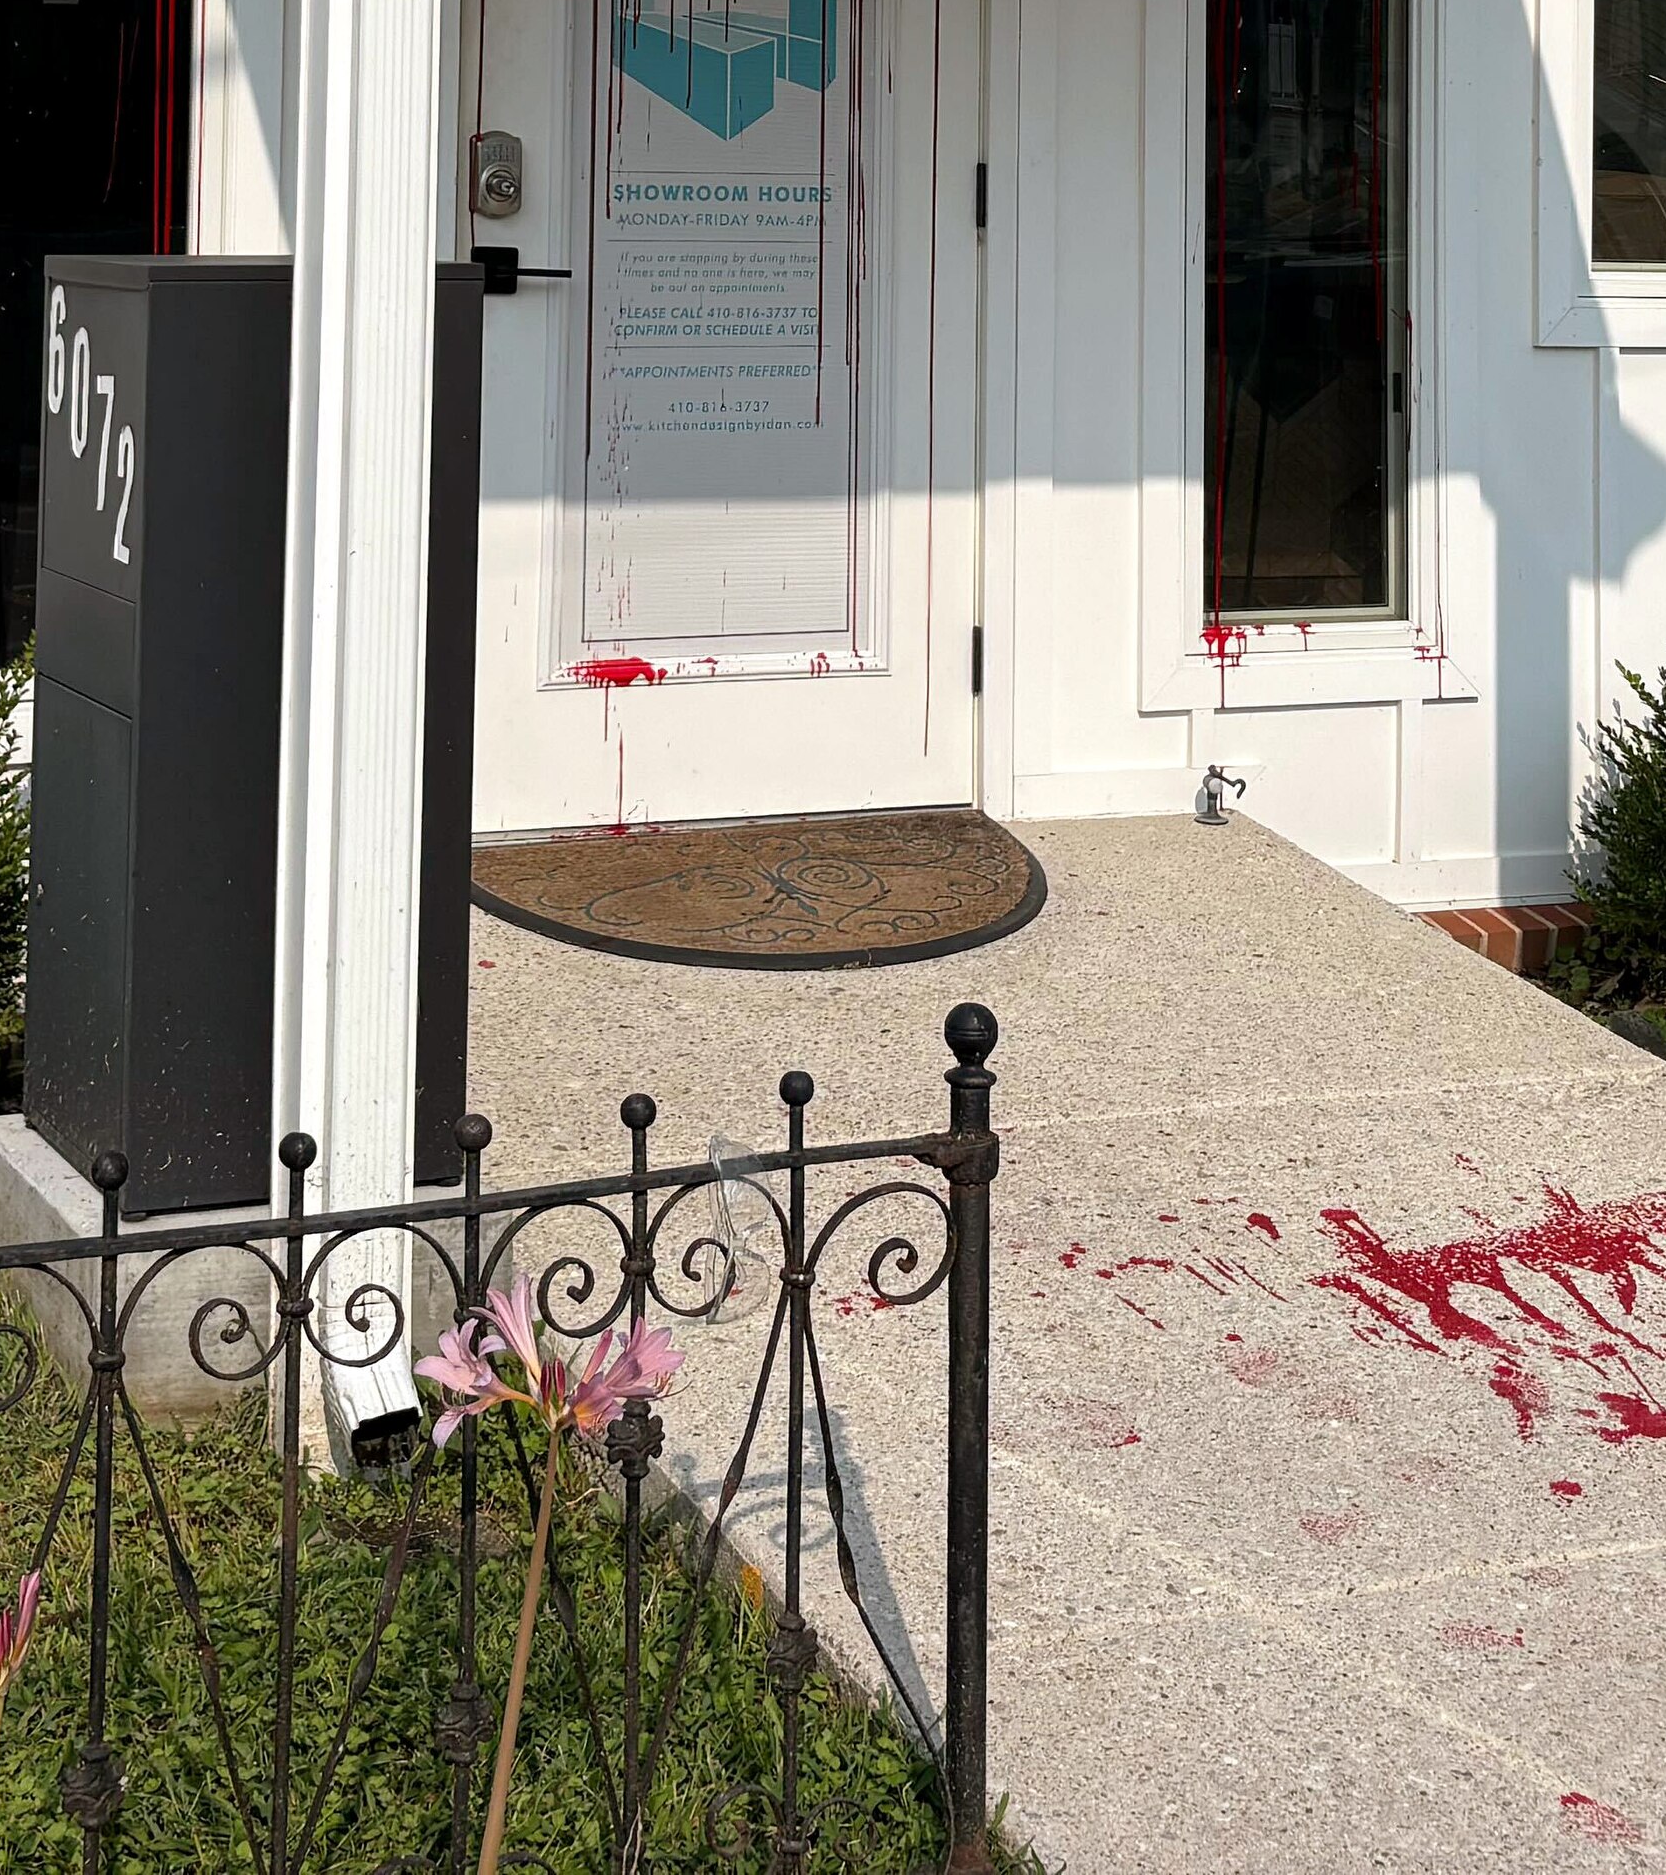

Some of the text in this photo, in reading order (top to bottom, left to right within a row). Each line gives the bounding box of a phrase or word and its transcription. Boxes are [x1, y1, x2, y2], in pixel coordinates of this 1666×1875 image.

[614, 184, 833, 203] SHOWROOM HOURS
[616, 212, 750, 228] MONDAY-FRIDAY
[633, 254, 653, 264] you
[657, 254, 676, 263] are
[679, 252, 728, 265] stopping
[732, 252, 746, 264] by
[749, 252, 786, 265] during
[658, 267, 680, 278] and
[683, 269, 698, 278] no
[702, 269, 723, 278] one
[773, 270, 788, 278] we
[792, 270, 816, 280] may
[650, 282, 665, 293] be
[668, 283, 687, 293] out
[619, 306, 818, 319] PLEASE CALL 410-816-3737 TO
[614, 324, 678, 337] CONFIRM
[682, 324, 701, 336] OR
[705, 324, 773, 336] SCHEDULE
[777, 324, 787, 336] A
[668, 401, 770, 413] 410-816-3737
[47, 284, 134, 564] 6072
